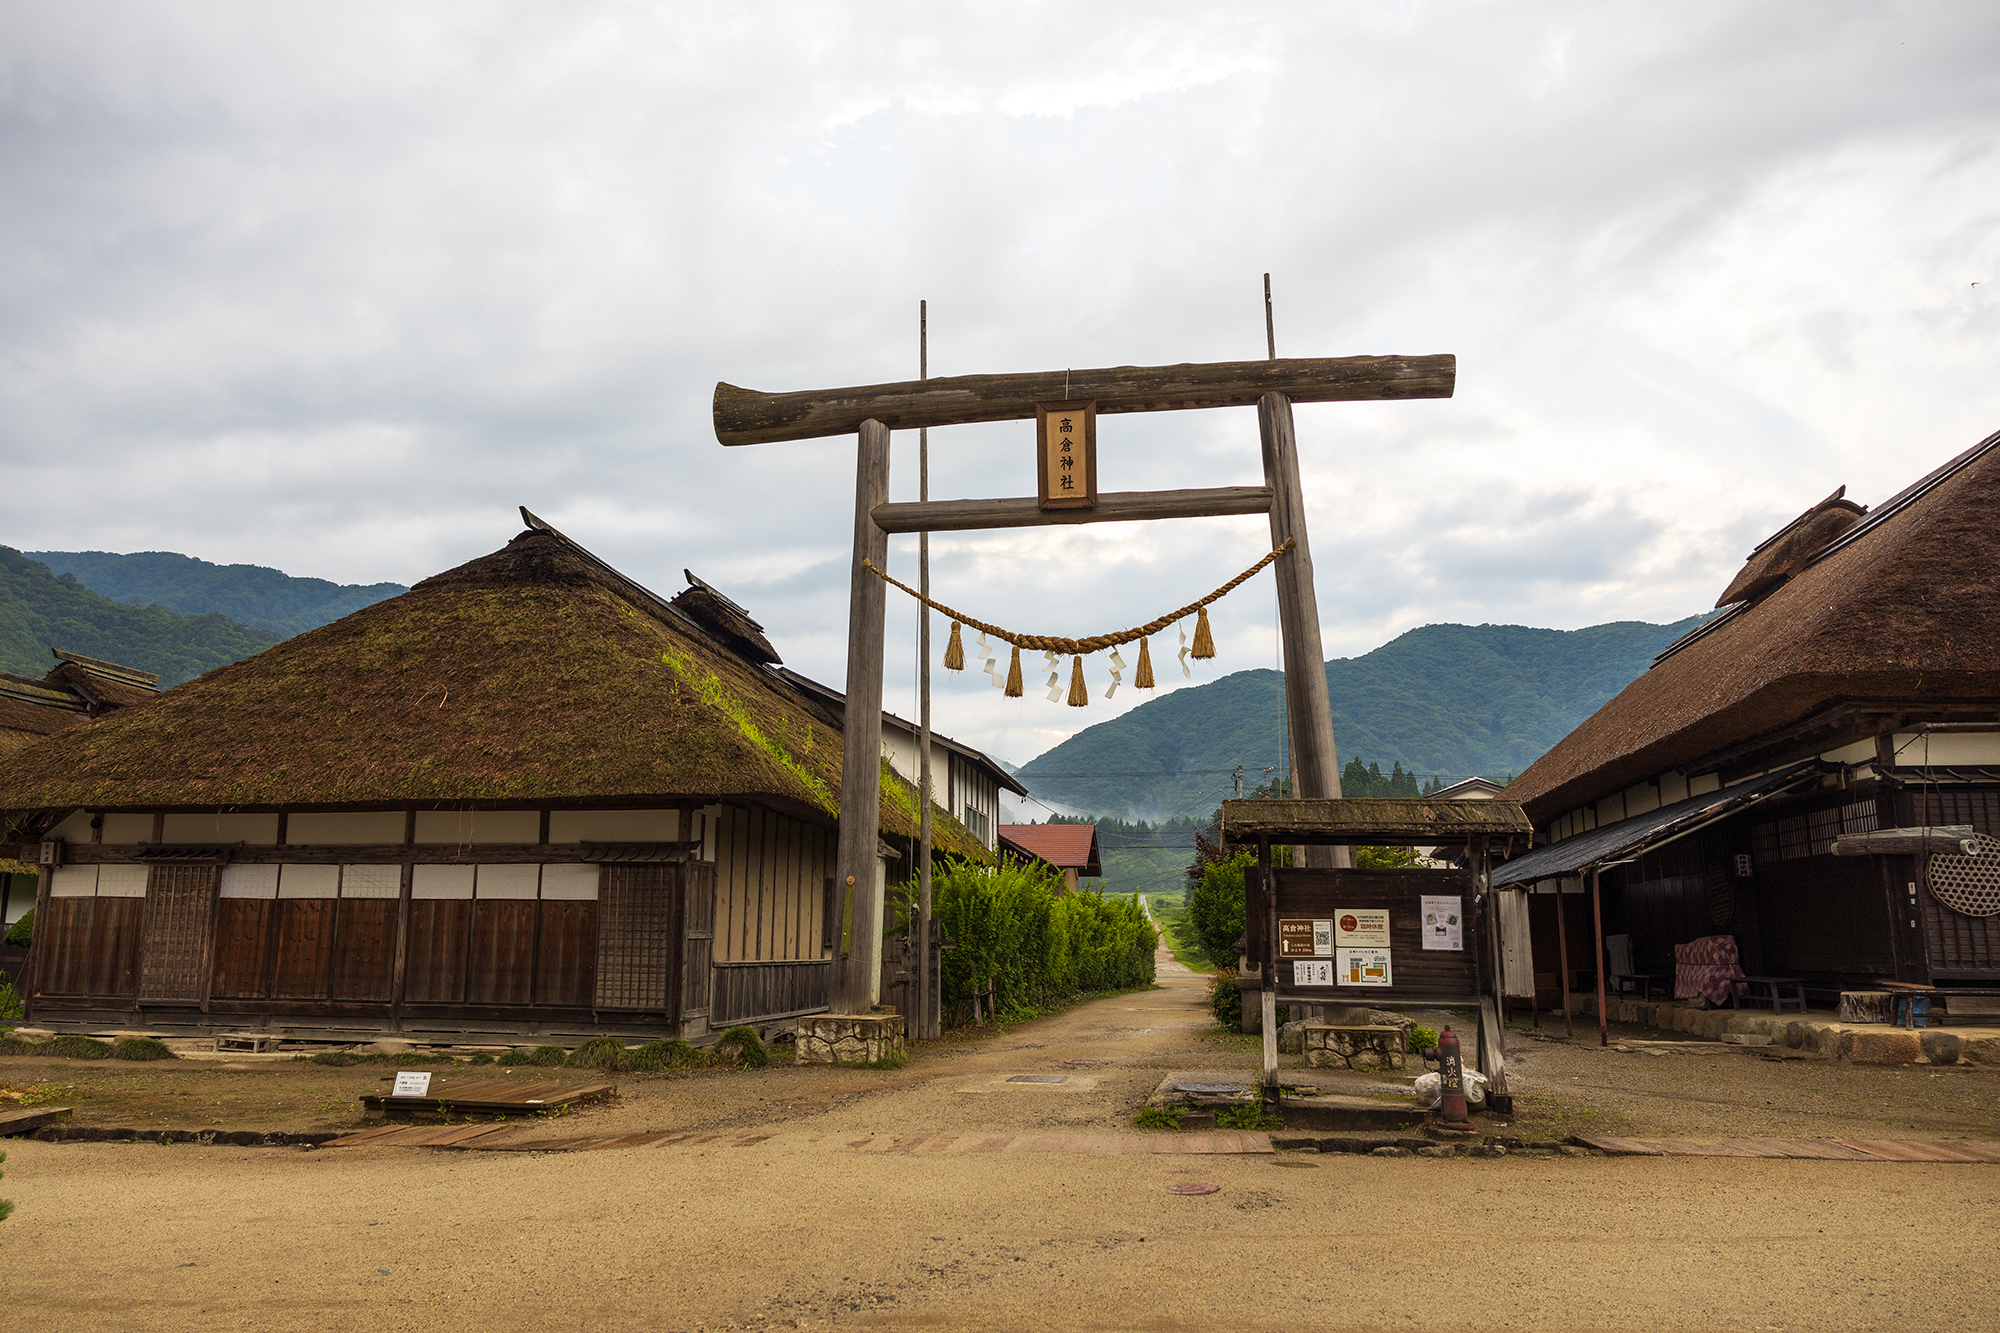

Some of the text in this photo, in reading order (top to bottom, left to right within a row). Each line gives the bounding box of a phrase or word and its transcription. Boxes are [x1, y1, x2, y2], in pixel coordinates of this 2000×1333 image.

[1059, 418, 1075, 491] 高倉神社
[1282, 924, 1311, 932] 高倉神社
[1446, 1055, 1458, 1088] 消火栓
